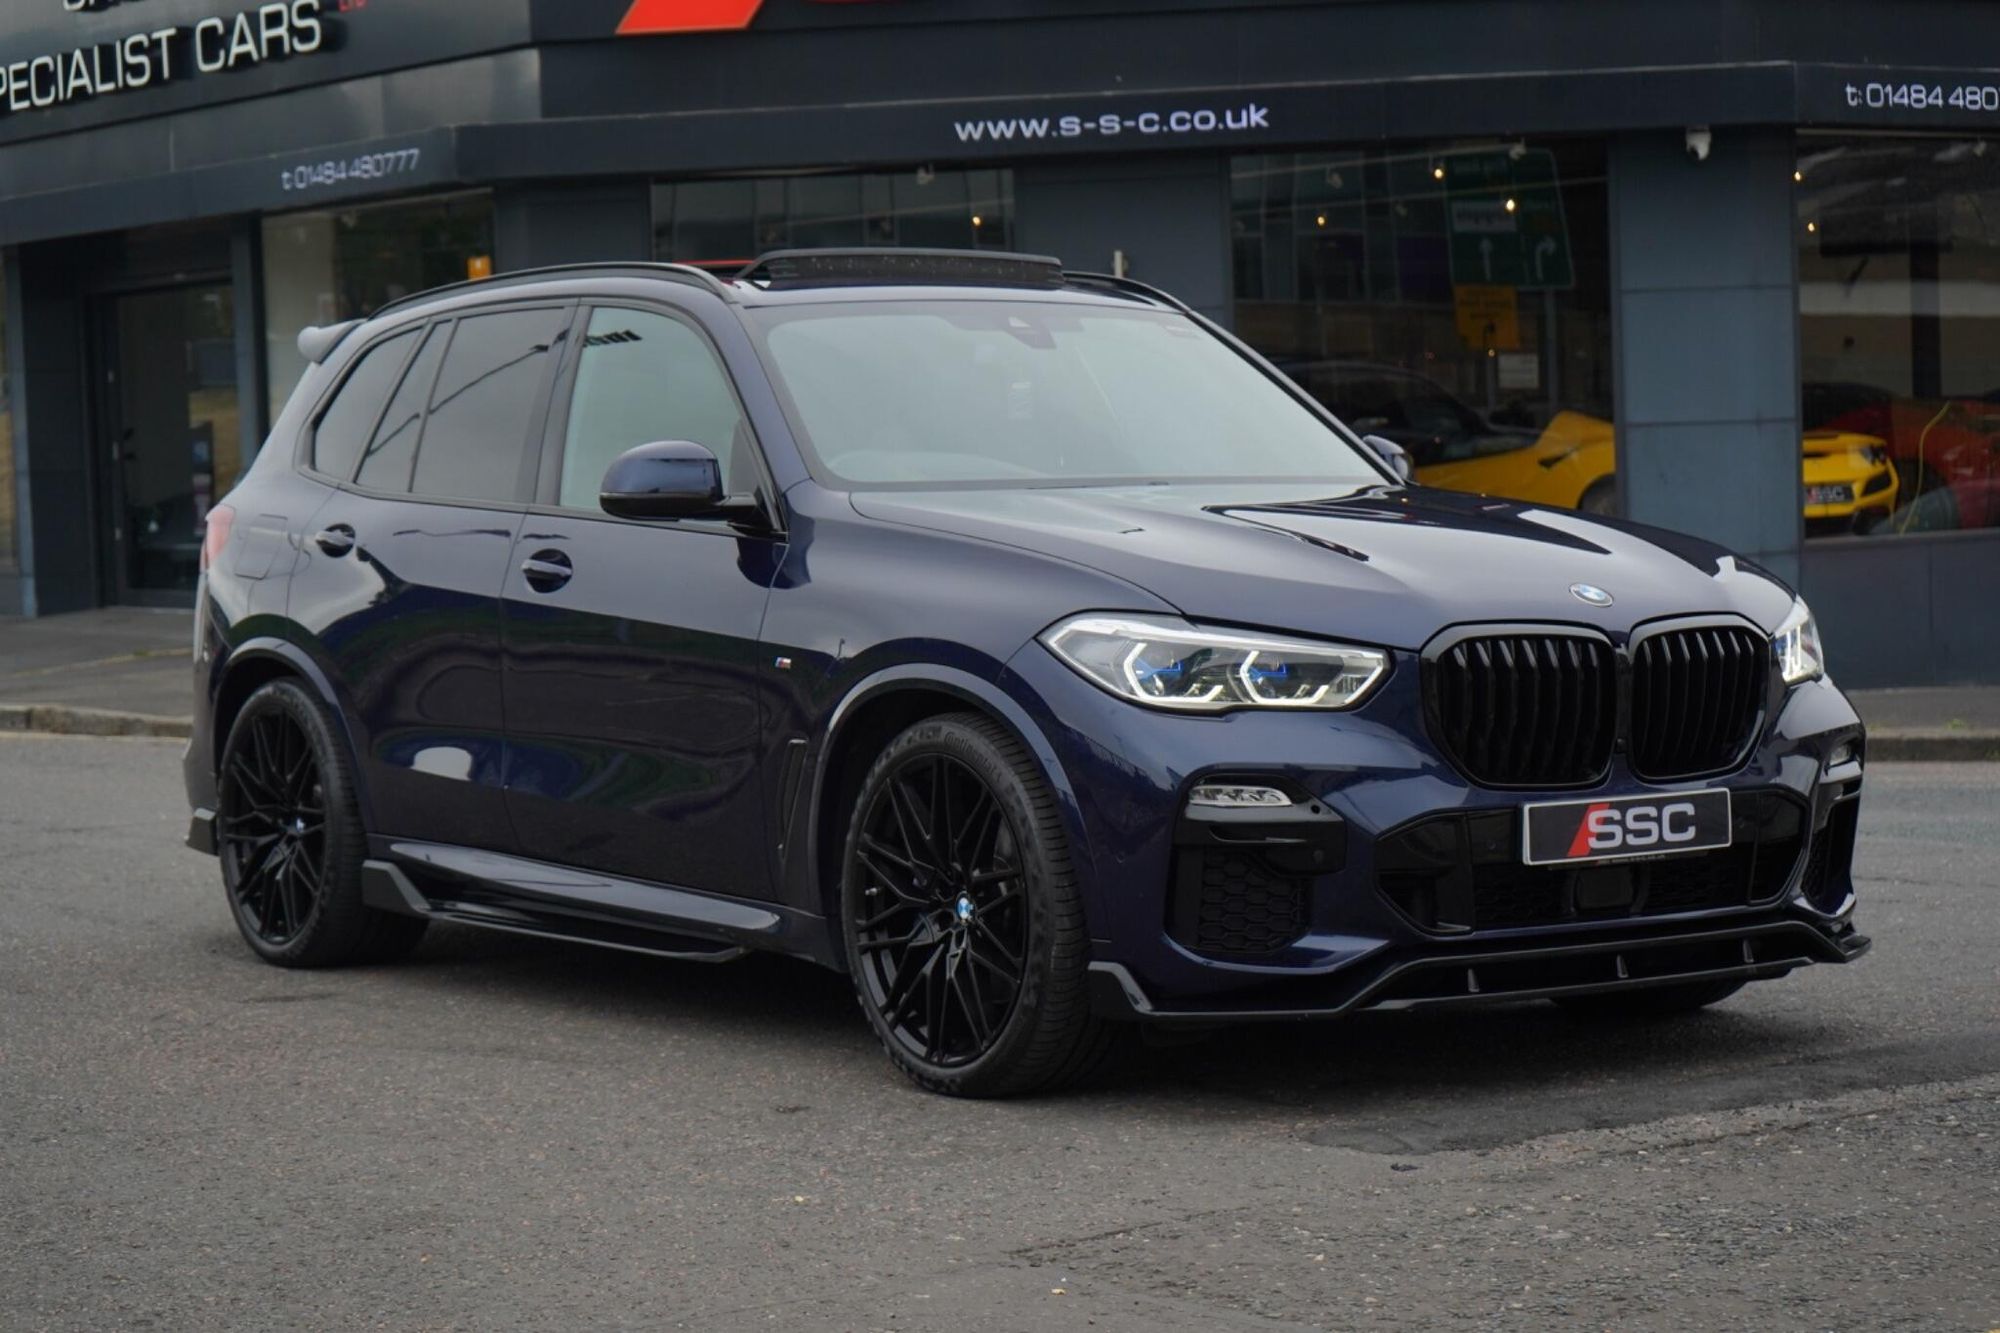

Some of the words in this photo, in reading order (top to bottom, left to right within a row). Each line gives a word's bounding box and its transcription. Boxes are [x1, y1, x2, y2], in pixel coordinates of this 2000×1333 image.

[195, 0, 321, 73] CARS
[1948, 85, 2000, 111] 480
[954, 103, 1269, 141] www.s-s-c.co.uk
[1587, 802, 1696, 849] SSC
